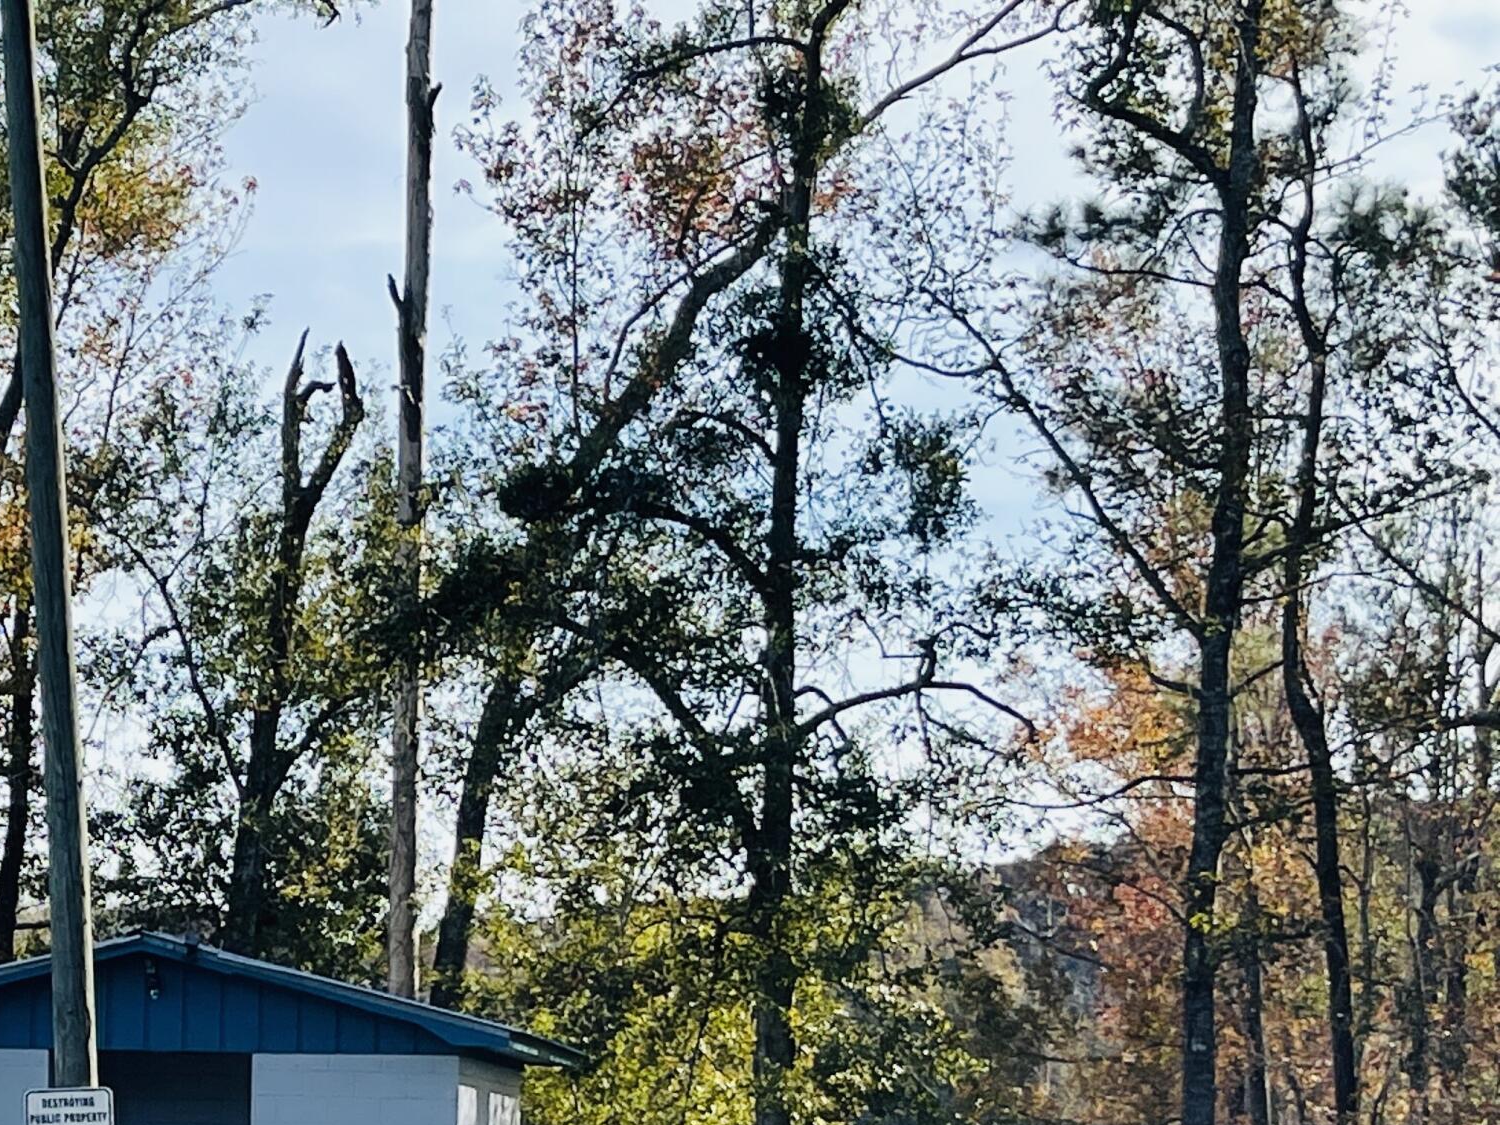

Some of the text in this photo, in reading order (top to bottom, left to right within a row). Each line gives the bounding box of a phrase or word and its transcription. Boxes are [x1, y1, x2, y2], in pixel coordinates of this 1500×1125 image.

[41, 1097, 95, 1109] DESTROYING
[30, 1111, 108, 1125] PUBLIC PROPERTY
